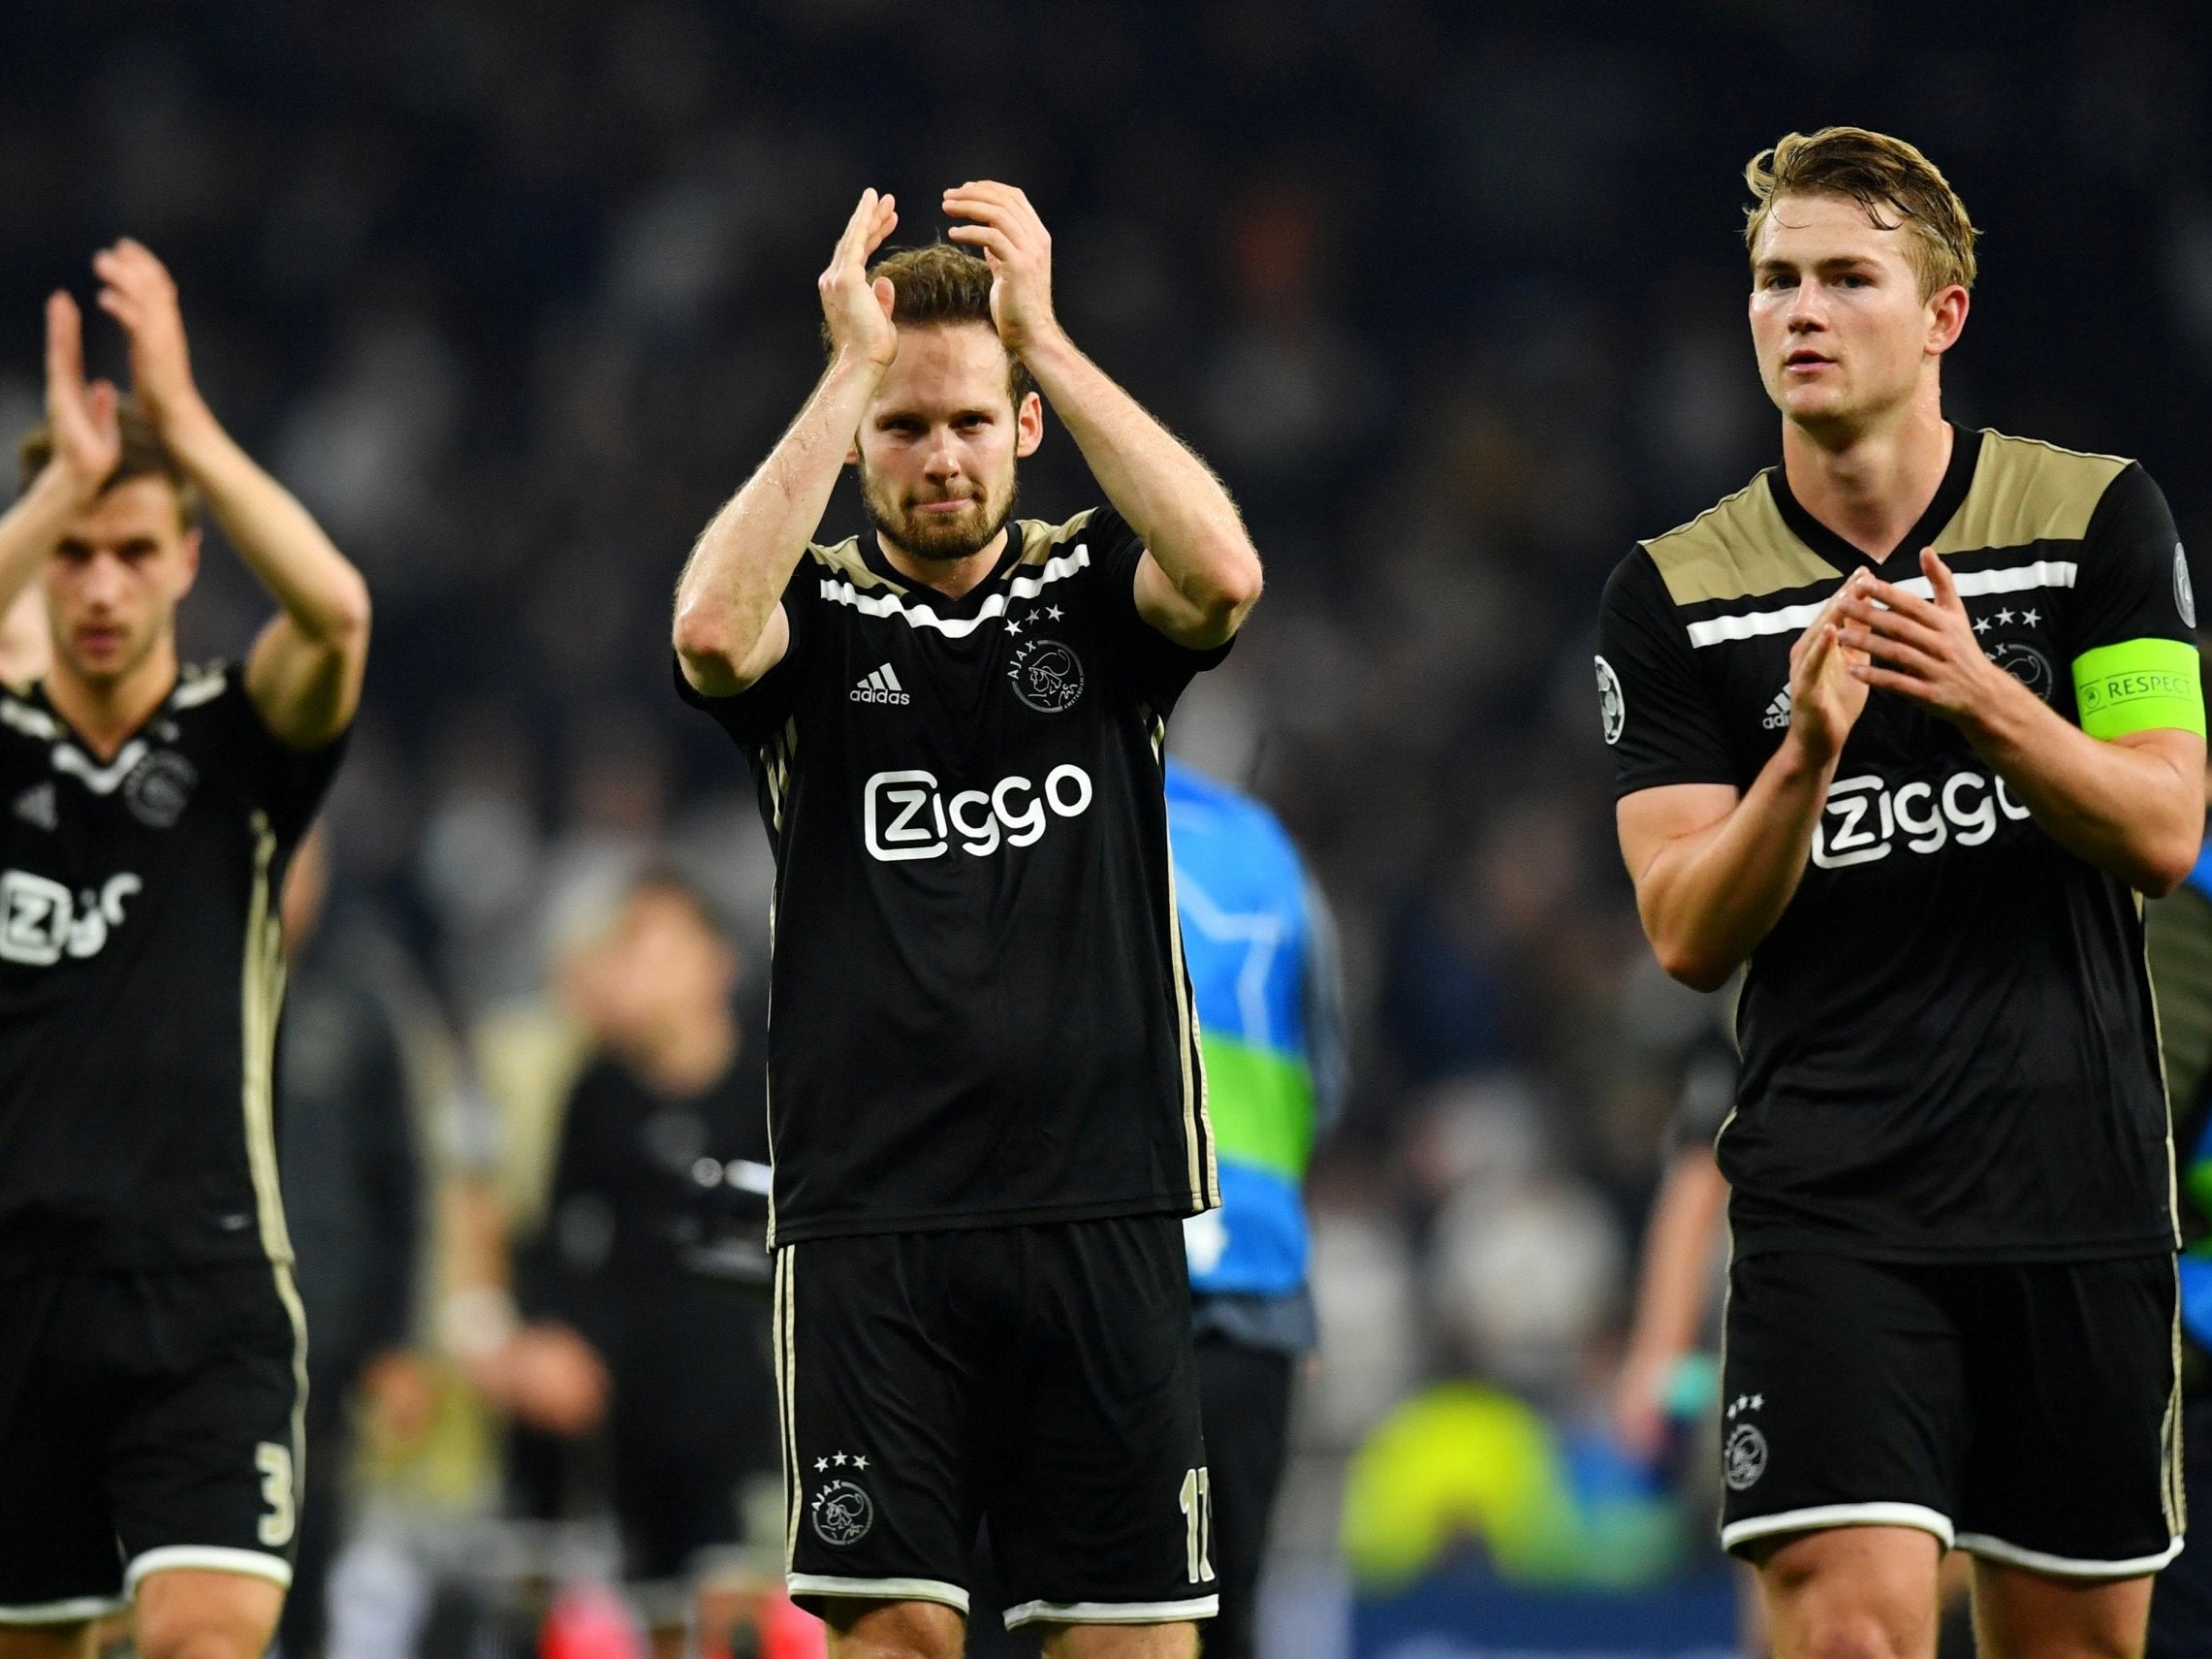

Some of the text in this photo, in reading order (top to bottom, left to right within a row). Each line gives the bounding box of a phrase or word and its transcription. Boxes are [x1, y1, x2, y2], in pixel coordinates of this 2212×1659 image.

[1007, 641, 1037, 680] AJAX
[850, 687, 910, 706] adidas
[2107, 676, 2192, 699] RESPECT
[254, 1441, 296, 1547] 3
[811, 1479, 841, 1512] AJAX
